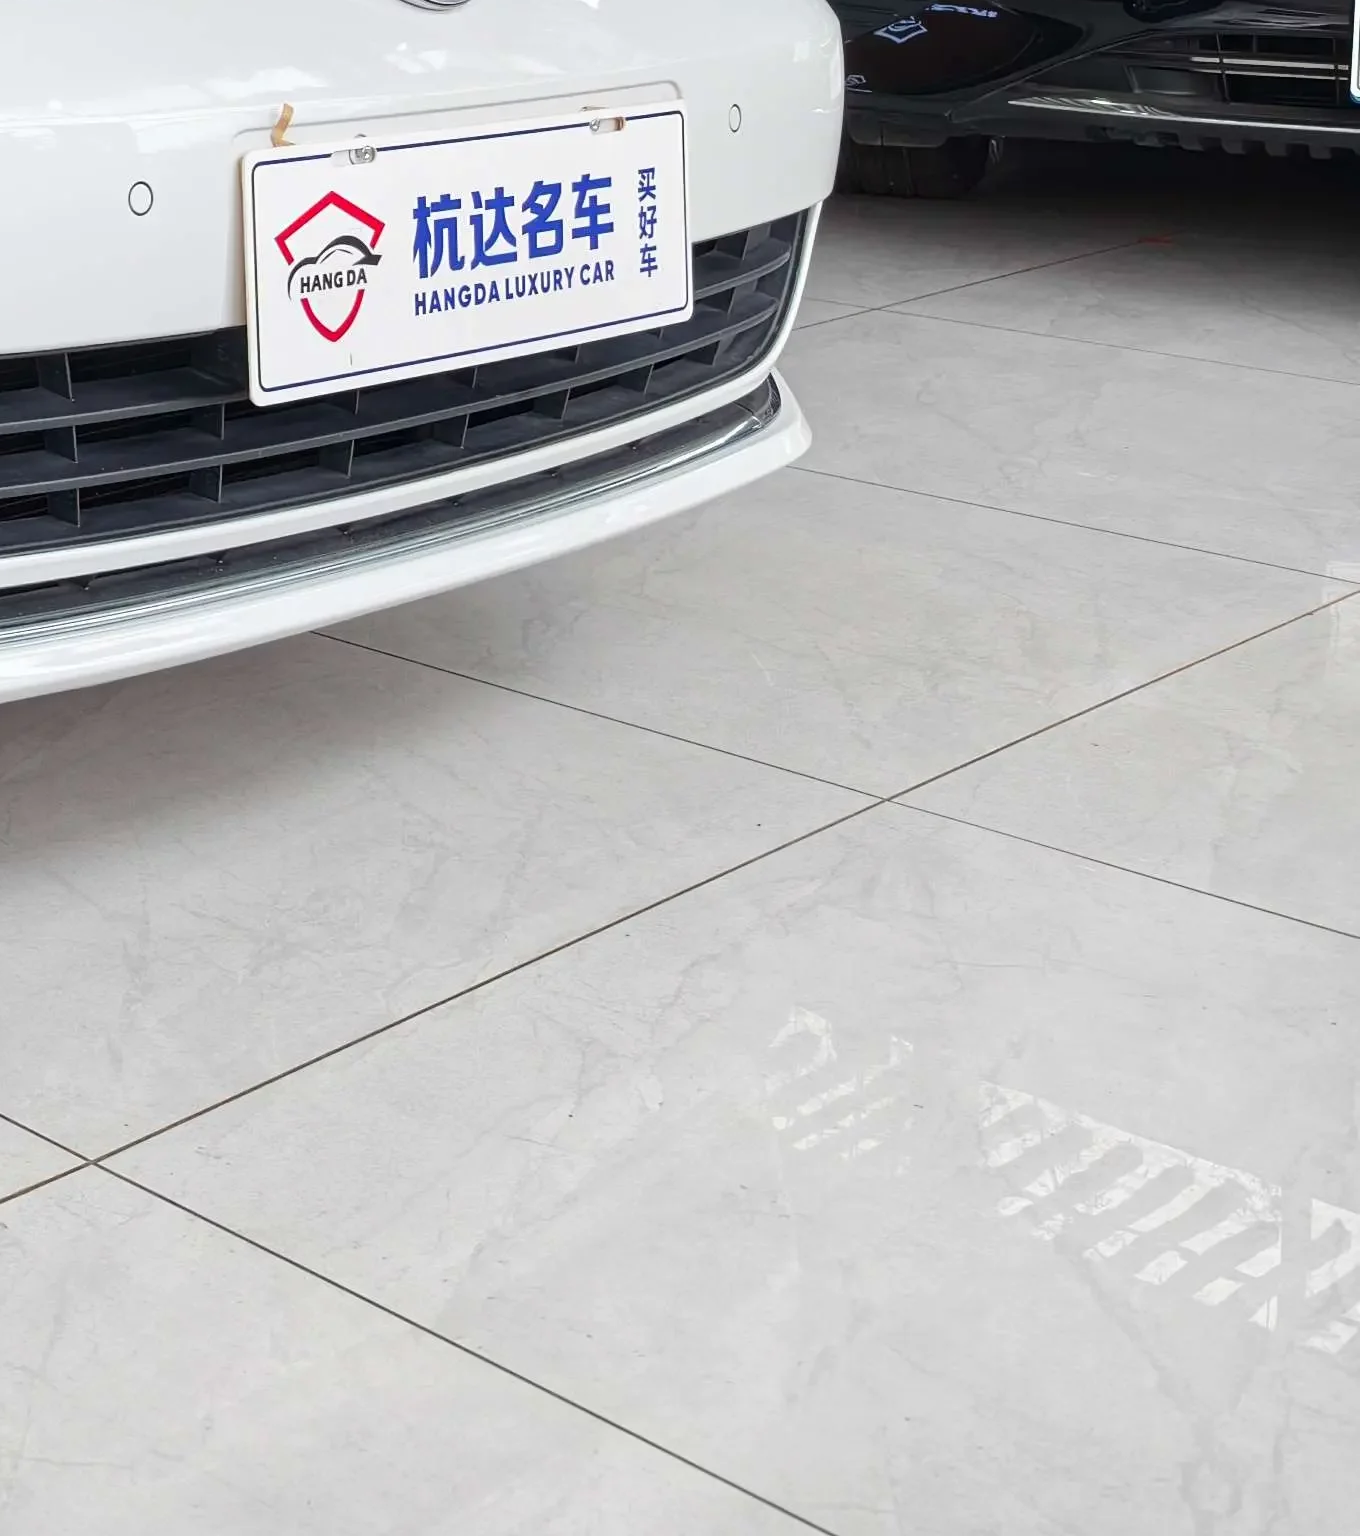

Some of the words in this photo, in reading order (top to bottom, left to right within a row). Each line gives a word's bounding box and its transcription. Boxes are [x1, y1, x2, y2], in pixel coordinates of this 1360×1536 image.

[412, 173, 615, 280] 杭达名车
[636, 167, 659, 278] 买好车
[299, 269, 346, 295] HANG
[346, 264, 368, 287] DA
[414, 280, 502, 317] HANGDA
[505, 268, 576, 301] LUXURY
[579, 259, 616, 287] CAR
